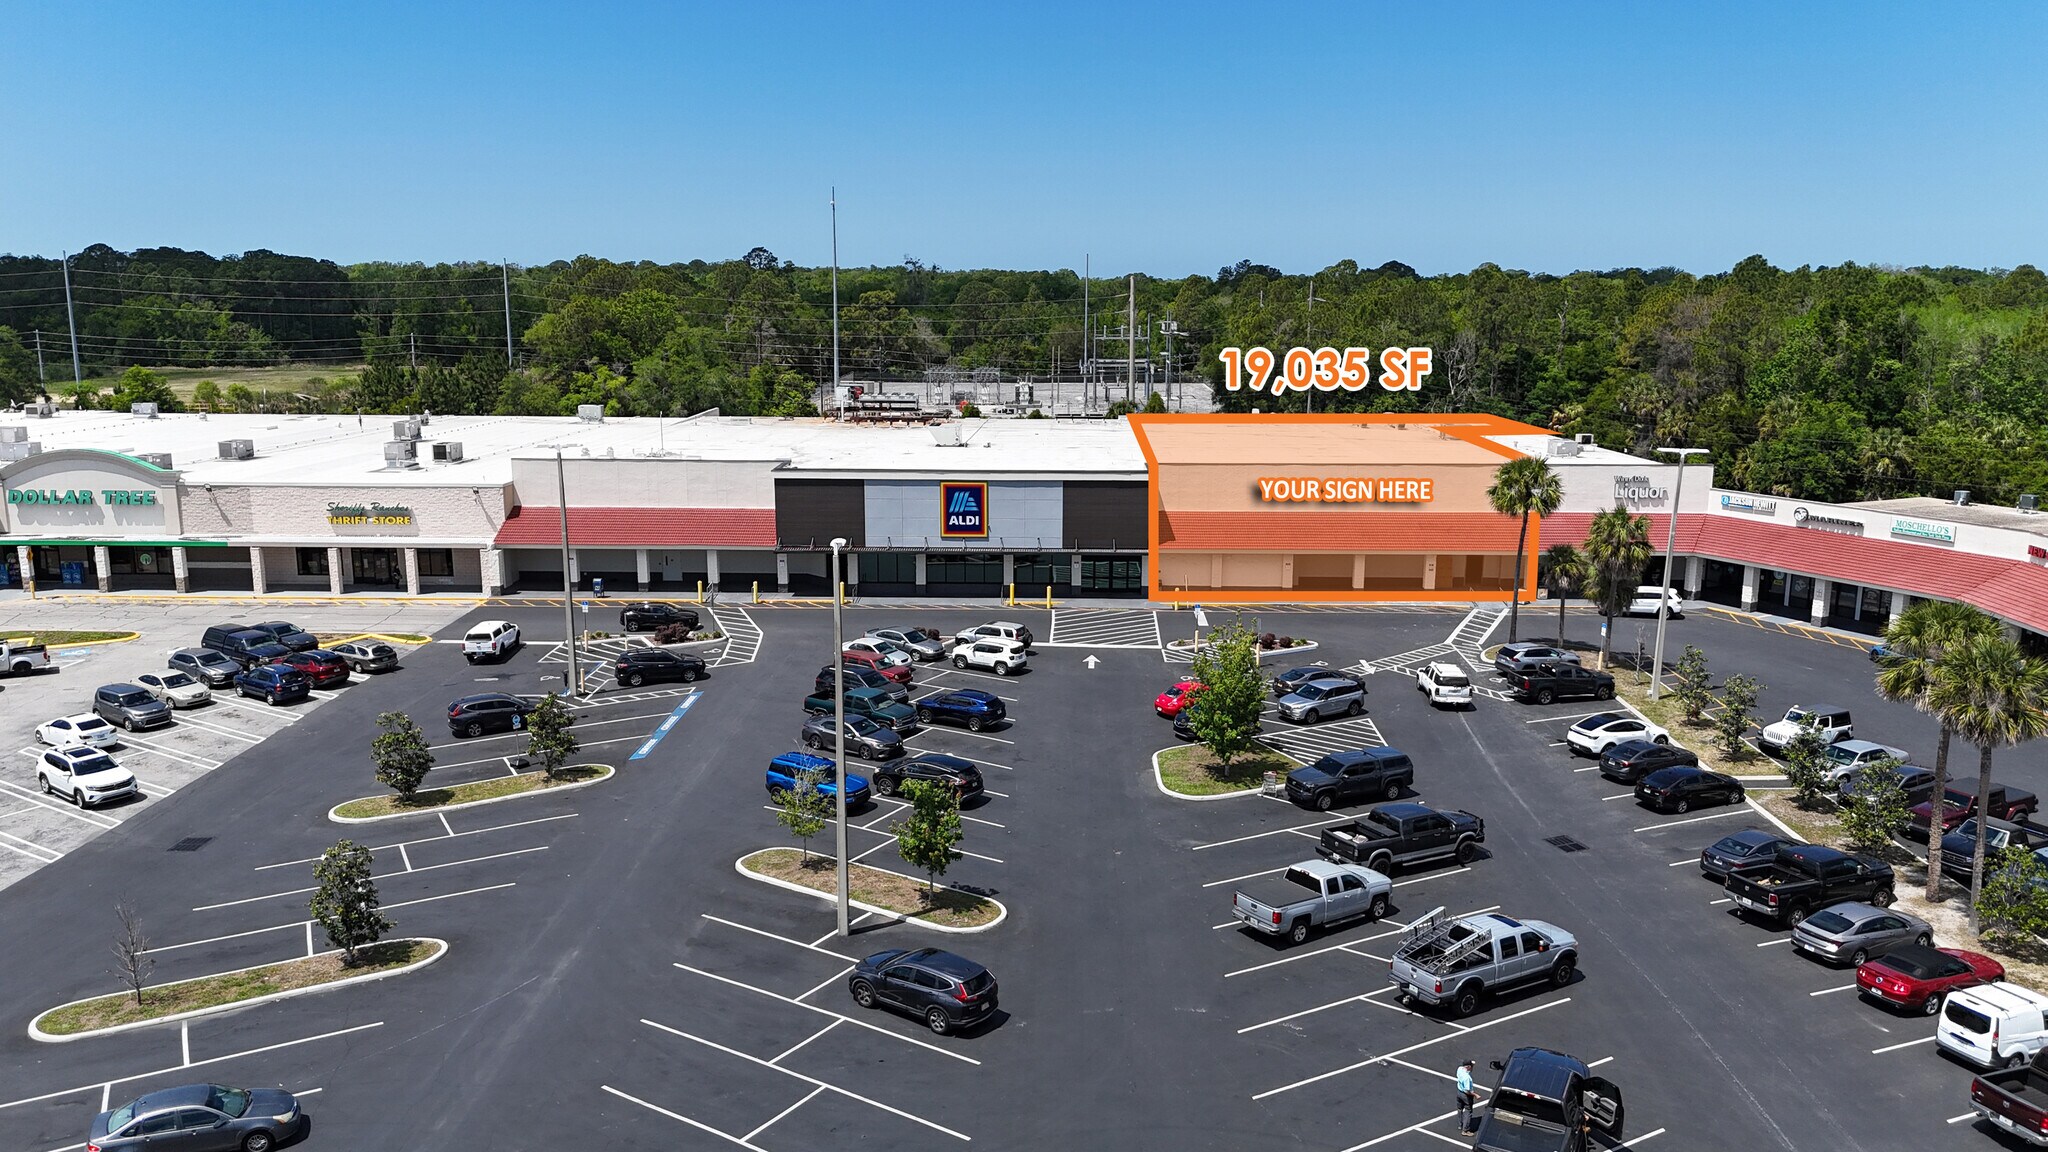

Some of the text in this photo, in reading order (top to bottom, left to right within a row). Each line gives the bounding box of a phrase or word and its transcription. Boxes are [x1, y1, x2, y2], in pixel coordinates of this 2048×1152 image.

[8, 489, 156, 505] DOLLAR TREE
[1614, 482, 1668, 503] Liquor
[327, 516, 411, 525] THRIFT STORE
[949, 515, 979, 526] ALDI
[1896, 519, 1950, 535] MOSCHELLO'S
